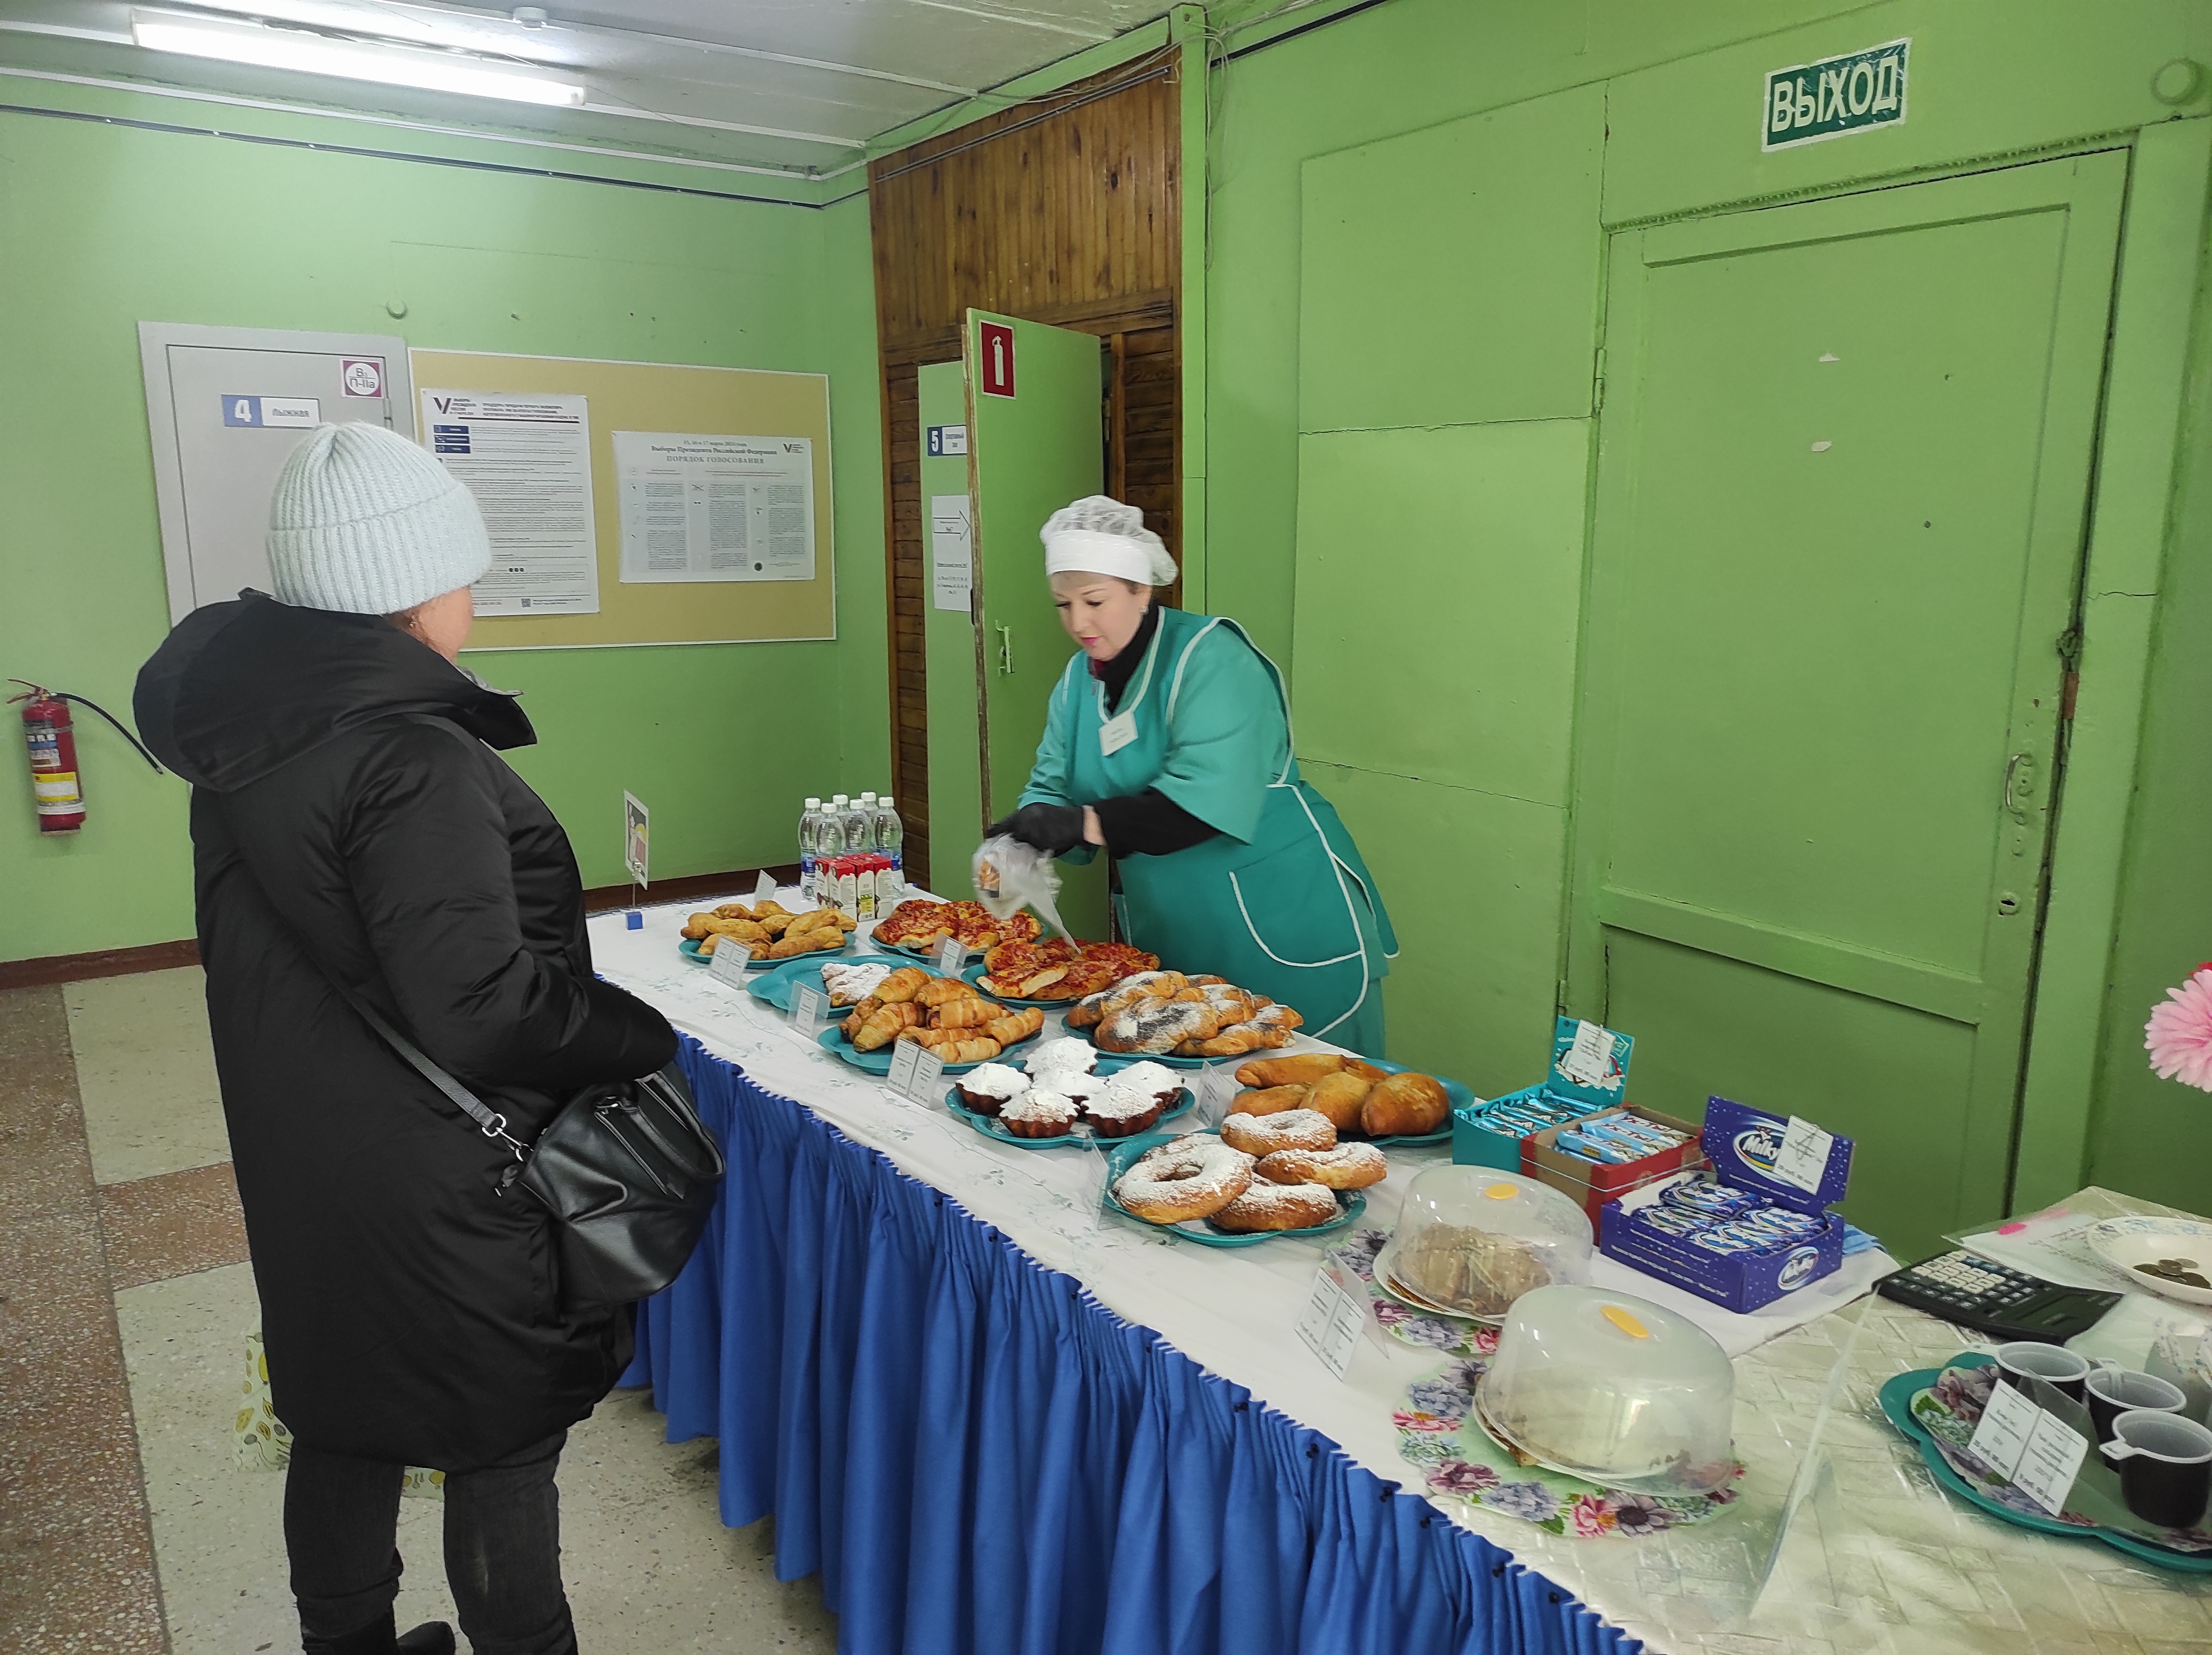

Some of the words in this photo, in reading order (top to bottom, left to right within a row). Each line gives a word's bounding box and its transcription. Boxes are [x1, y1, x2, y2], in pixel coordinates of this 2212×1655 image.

[1772, 54, 1899, 133] ВЫХОД
[235, 399, 252, 422] 4
[931, 430, 939, 452] 5
